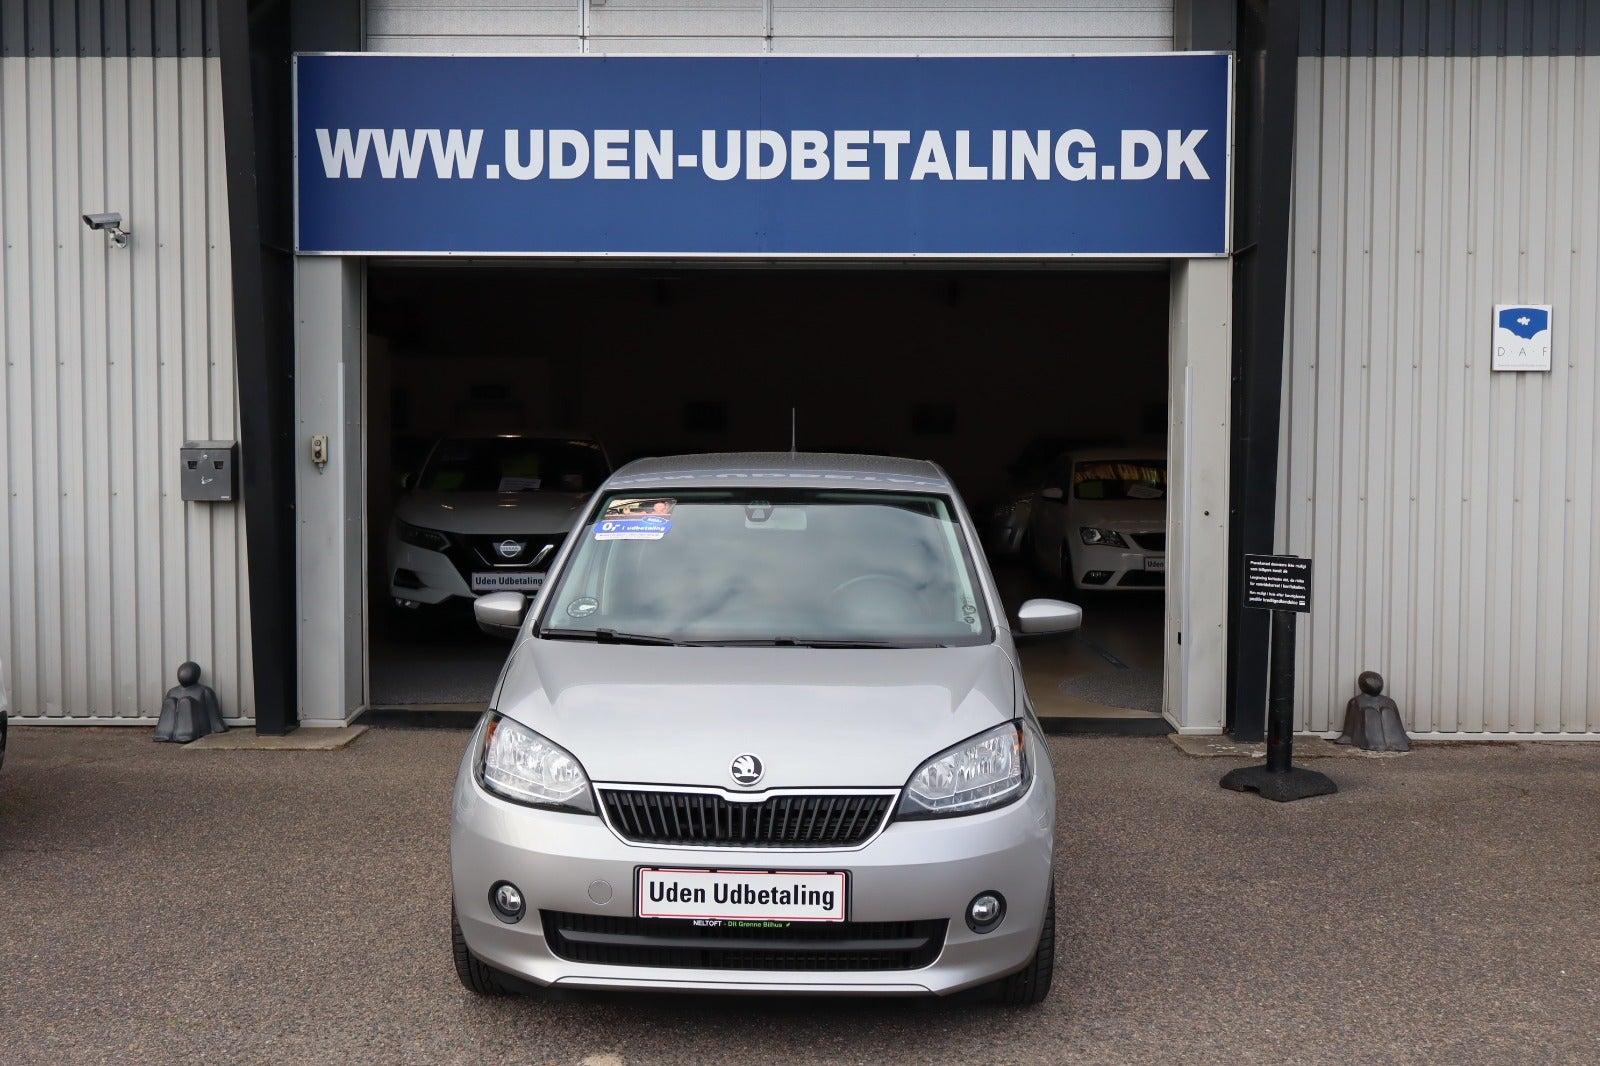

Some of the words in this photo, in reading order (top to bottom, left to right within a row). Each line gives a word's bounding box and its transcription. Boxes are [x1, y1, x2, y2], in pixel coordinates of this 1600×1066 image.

[315, 128, 1210, 181] WWW.UDEN-UDBETALING.DK
[475, 577, 497, 585] Uden
[498, 577, 543, 587] Udbetaling
[649, 881, 706, 903] Uden
[713, 882, 835, 911] Udbetaling
